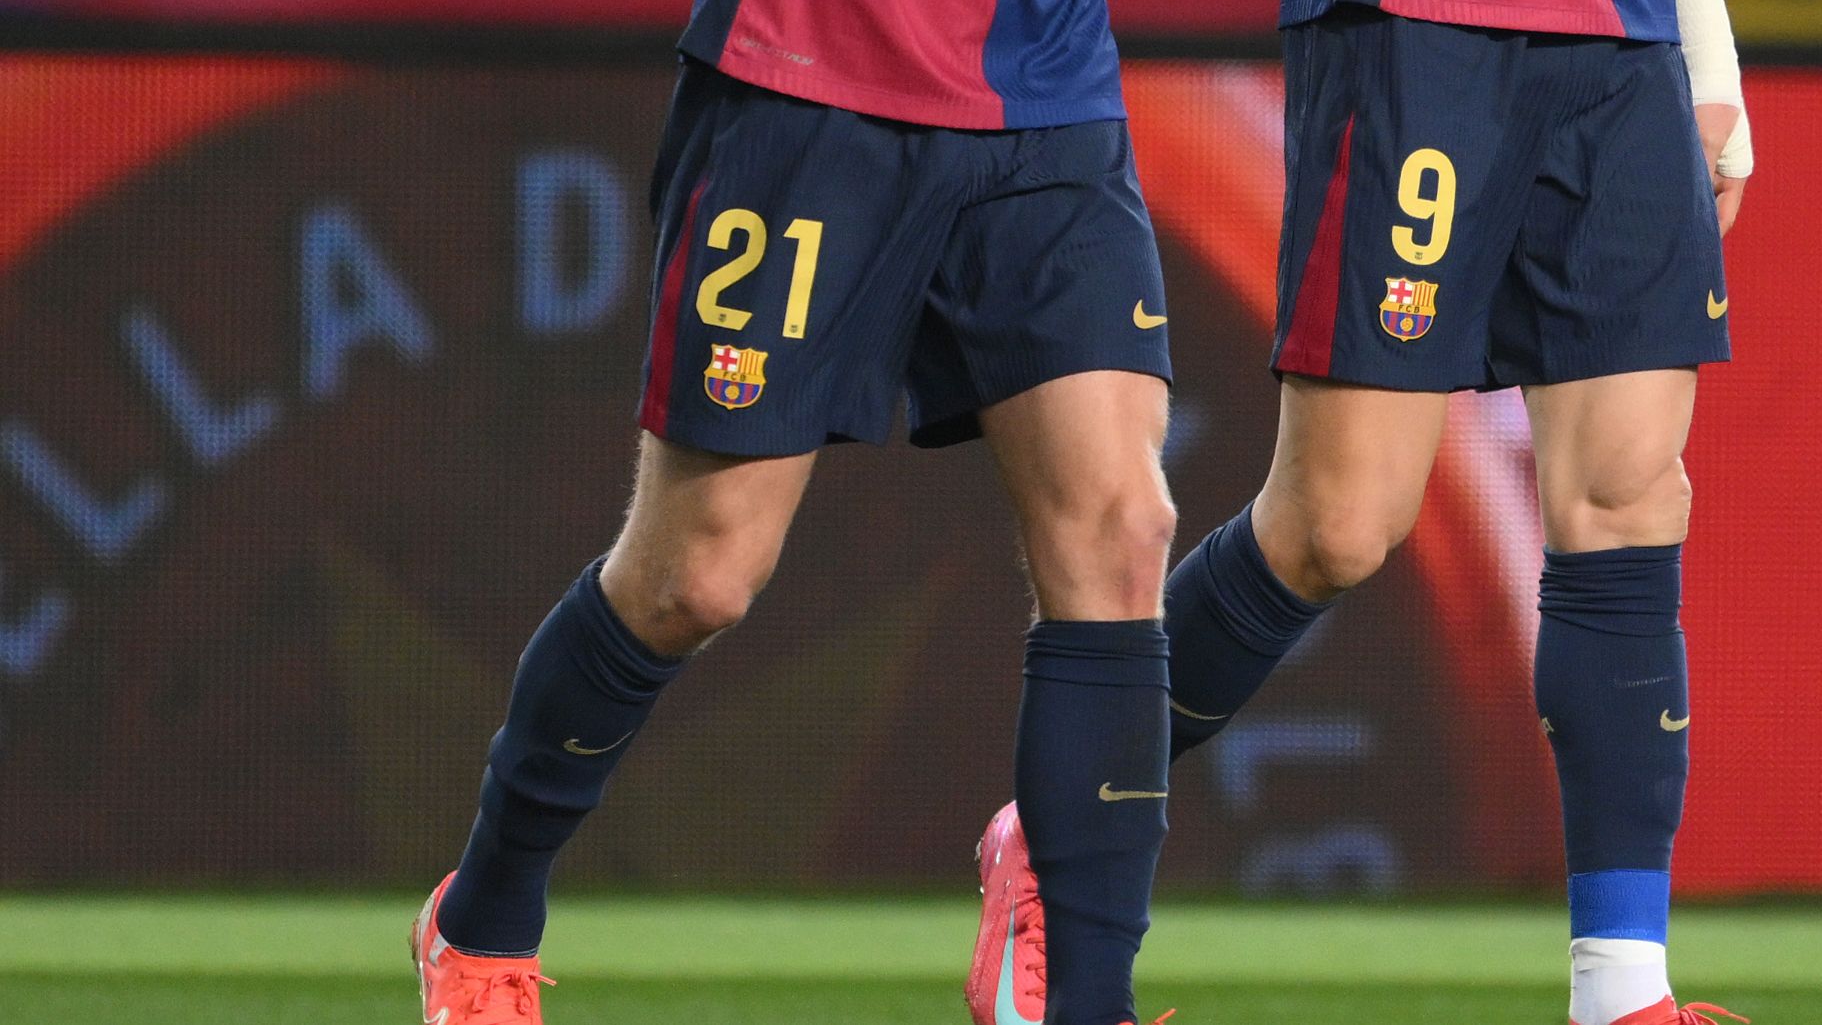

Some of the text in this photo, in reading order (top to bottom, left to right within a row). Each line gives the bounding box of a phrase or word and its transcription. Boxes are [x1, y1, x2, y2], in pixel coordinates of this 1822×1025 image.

[1391, 147, 1457, 266] 9
[695, 207, 824, 340] 21
[1398, 304, 1421, 314] FCB
